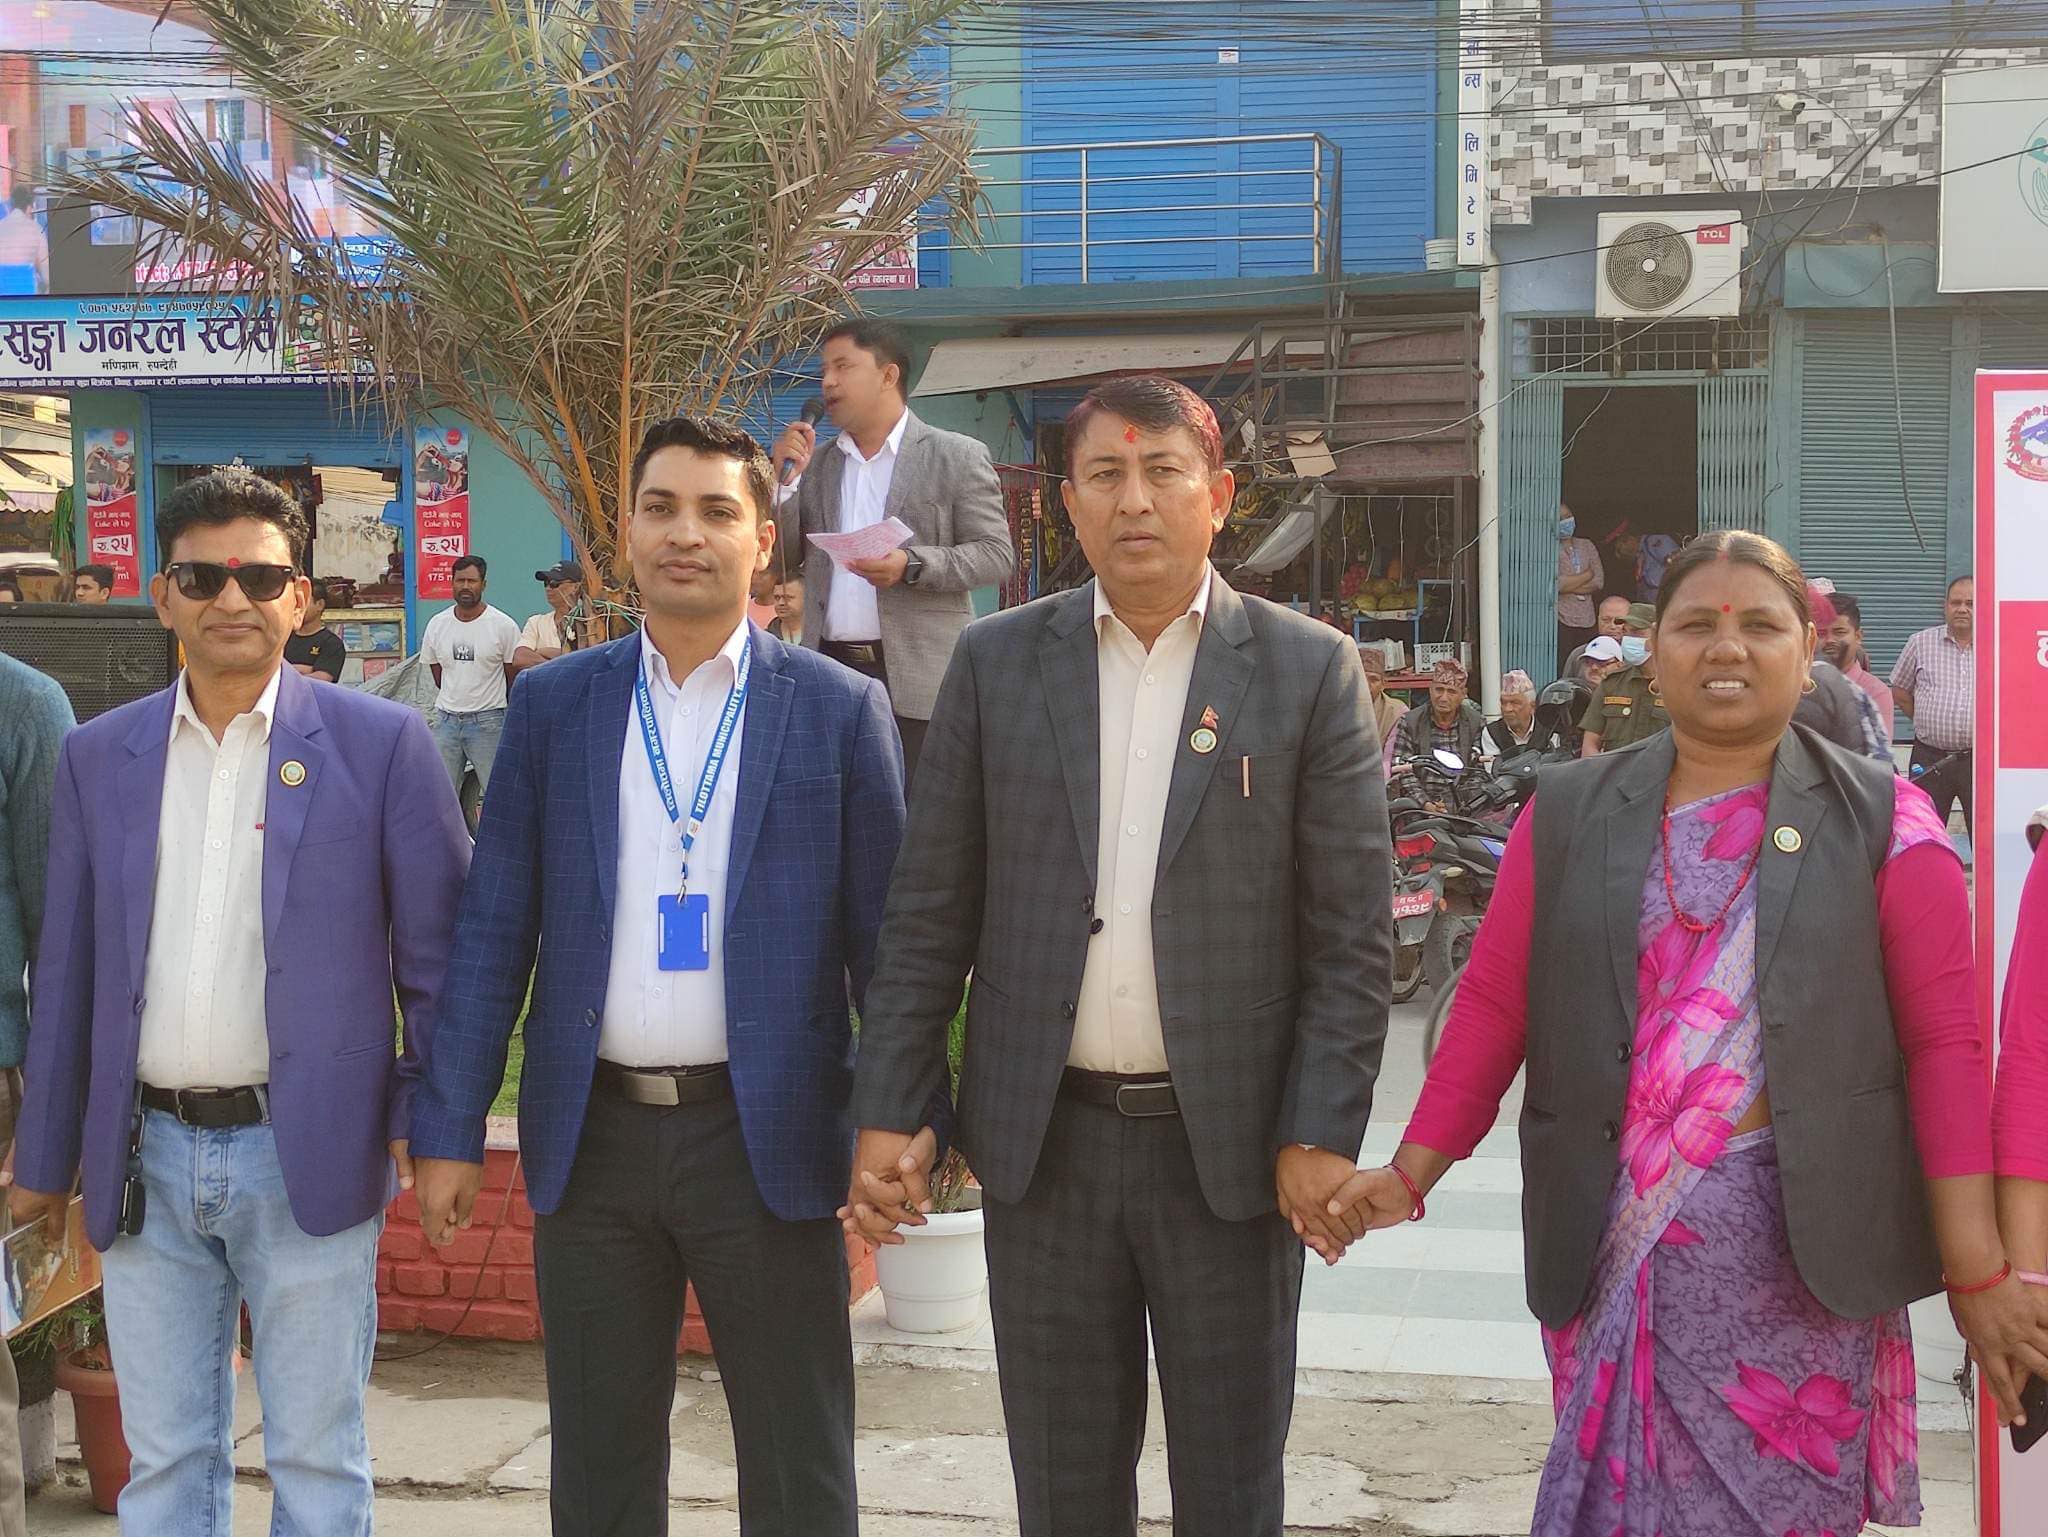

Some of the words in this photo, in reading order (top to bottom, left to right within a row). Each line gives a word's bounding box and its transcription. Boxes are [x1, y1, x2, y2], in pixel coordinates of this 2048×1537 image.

[1701, 229, 1726, 239] TCL
[77, 317, 187, 354] जनरल
[423, 519, 441, 527] Coke
[451, 519, 462, 528] Up
[111, 537, 129, 552] २५
[440, 538, 460, 553] २५
[427, 572, 444, 581] 175
[695, 756, 720, 814] TILOTTAMA
[713, 692, 743, 759] MUNICIPALITY,
